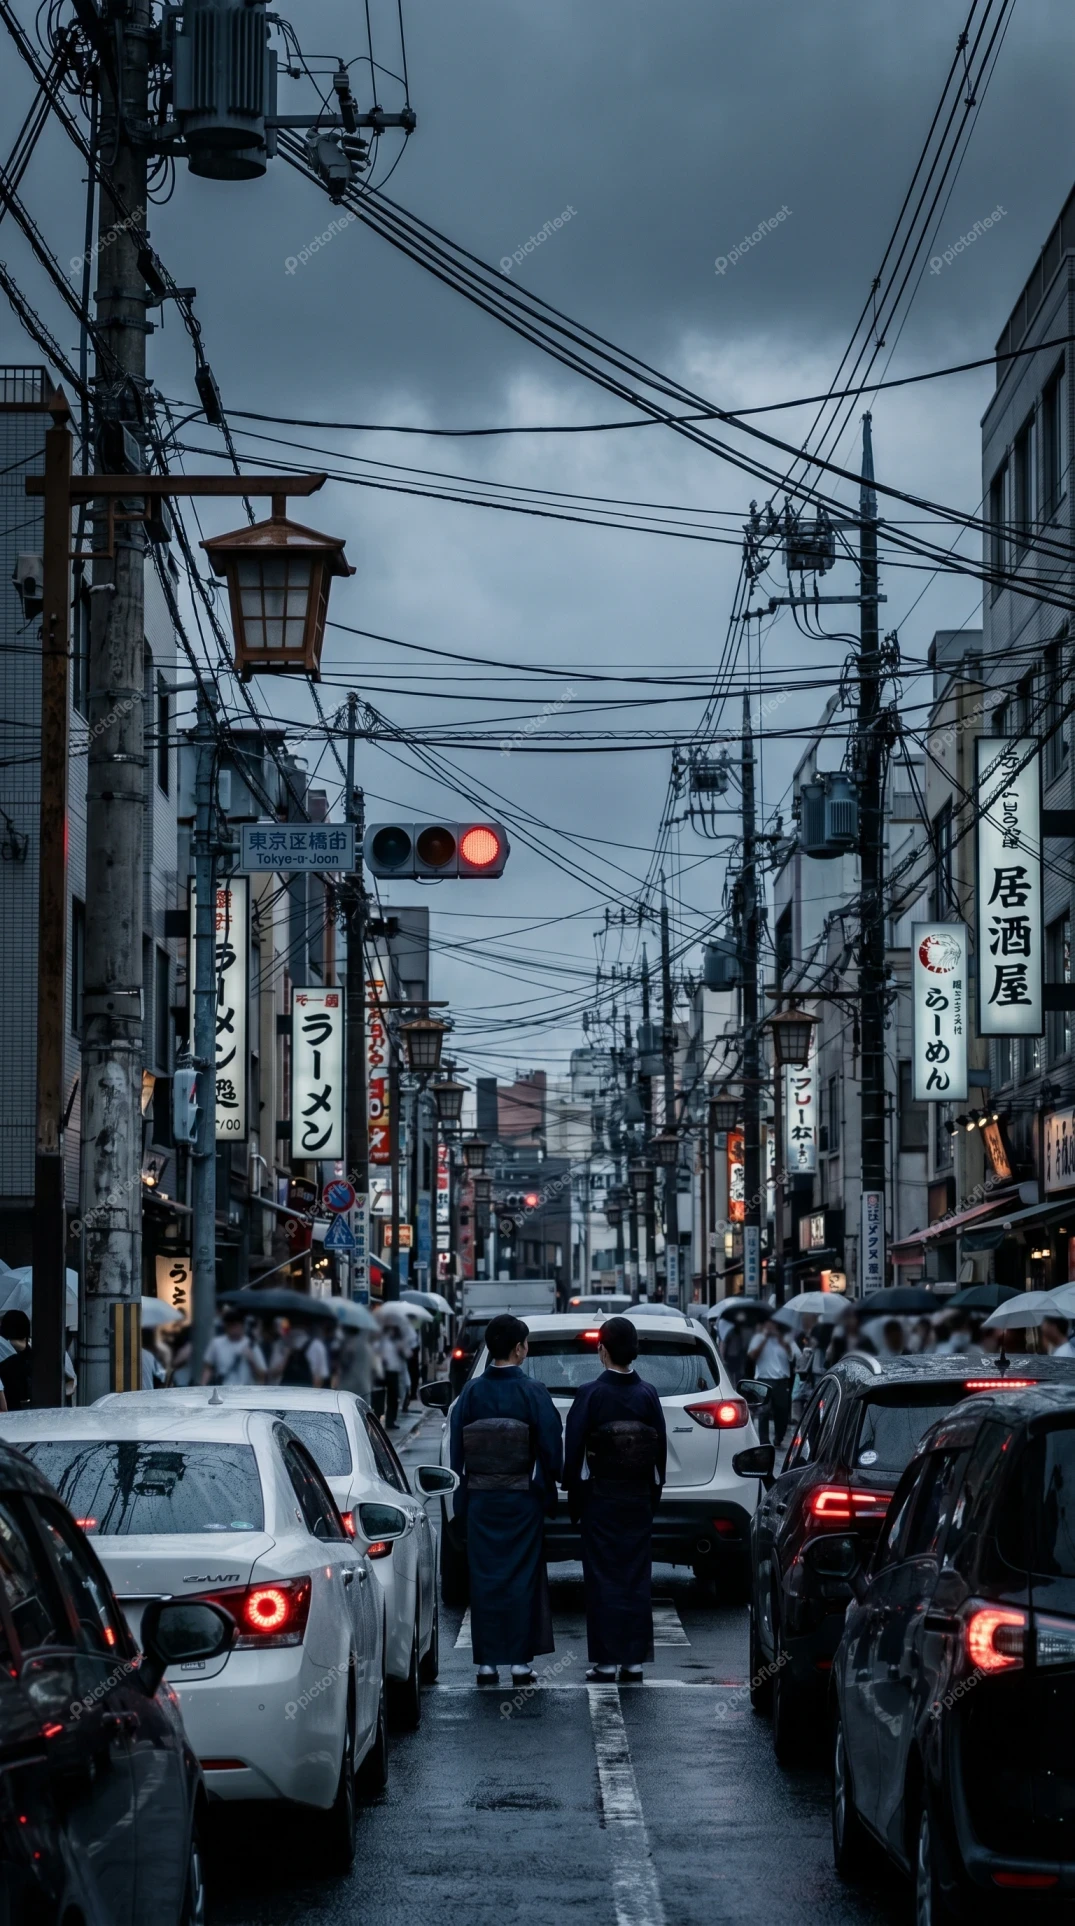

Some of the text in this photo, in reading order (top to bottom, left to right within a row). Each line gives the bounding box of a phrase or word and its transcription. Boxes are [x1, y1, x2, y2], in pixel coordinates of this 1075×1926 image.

[987, 866, 1033, 1006] 居酒屋
[301, 1013, 333, 1151] ラーメン
[925, 987, 951, 1091] らーめん
